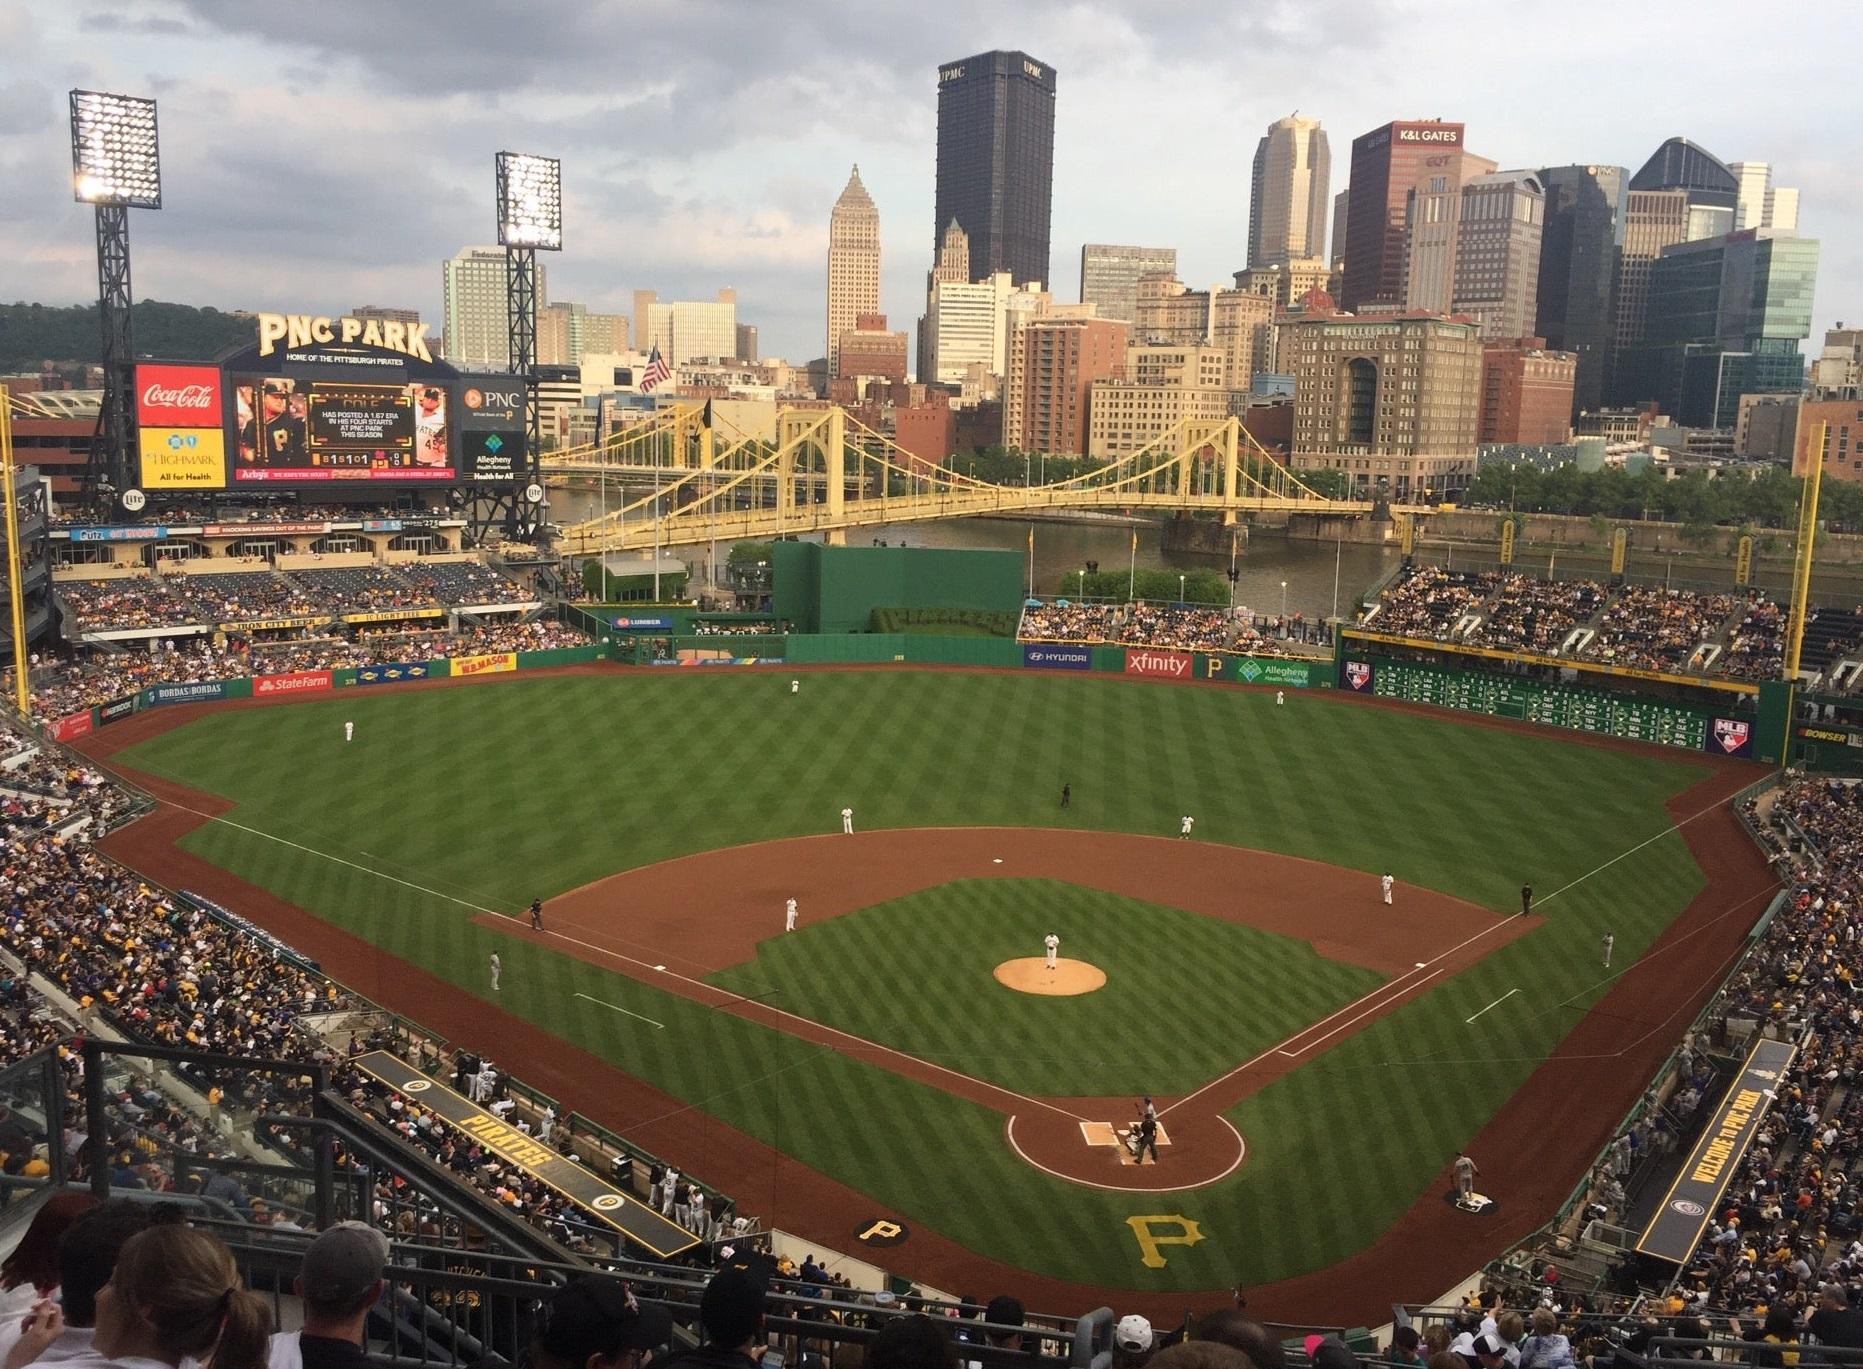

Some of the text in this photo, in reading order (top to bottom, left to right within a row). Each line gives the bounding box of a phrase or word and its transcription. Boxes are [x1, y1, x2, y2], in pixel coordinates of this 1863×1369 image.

[940, 66, 965, 81] UPMC
[1024, 60, 1042, 79] UPMC
[1400, 130, 1420, 140] K&L
[1422, 130, 1456, 142] GATES
[472, 250, 507, 258] Federate
[258, 312, 432, 364] PNC PARK
[286, 354, 308, 362] HOME
[319, 355, 333, 363] THE
[334, 356, 376, 365] PITTSBURGH
[377, 358, 404, 366] PIRATES
[144, 384, 214, 408] Coca-Cola
[484, 392, 520, 408] PNC
[154, 454, 216, 465] HIGHMARK
[330, 455, 337, 464] 1
[346, 455, 352, 464] 1
[361, 455, 368, 464] 1
[477, 456, 512, 464] Allegheny
[125, 494, 142, 505] Lite
[529, 489, 541, 498] Lite
[237, 618, 315, 630] IRON CITY BEER
[478, 655, 508, 668] MASON
[1046, 654, 1087, 662] HYUNDAI
[1130, 653, 1187, 675] xfinity
[1208, 658, 1223, 678] P
[1265, 666, 1308, 678] Allegheny
[276, 677, 327, 689] State Farm
[159, 685, 221, 697] BORDAS BORDAS
[1717, 721, 1746, 733] MLB
[1806, 730, 1846, 743] BOWSER
[460, 1114, 553, 1166] PIRATES
[1691, 1089, 1762, 1183] WELCOME TO PNC PARK
[858, 1220, 902, 1240] P
[1125, 1214, 1207, 1269] P
